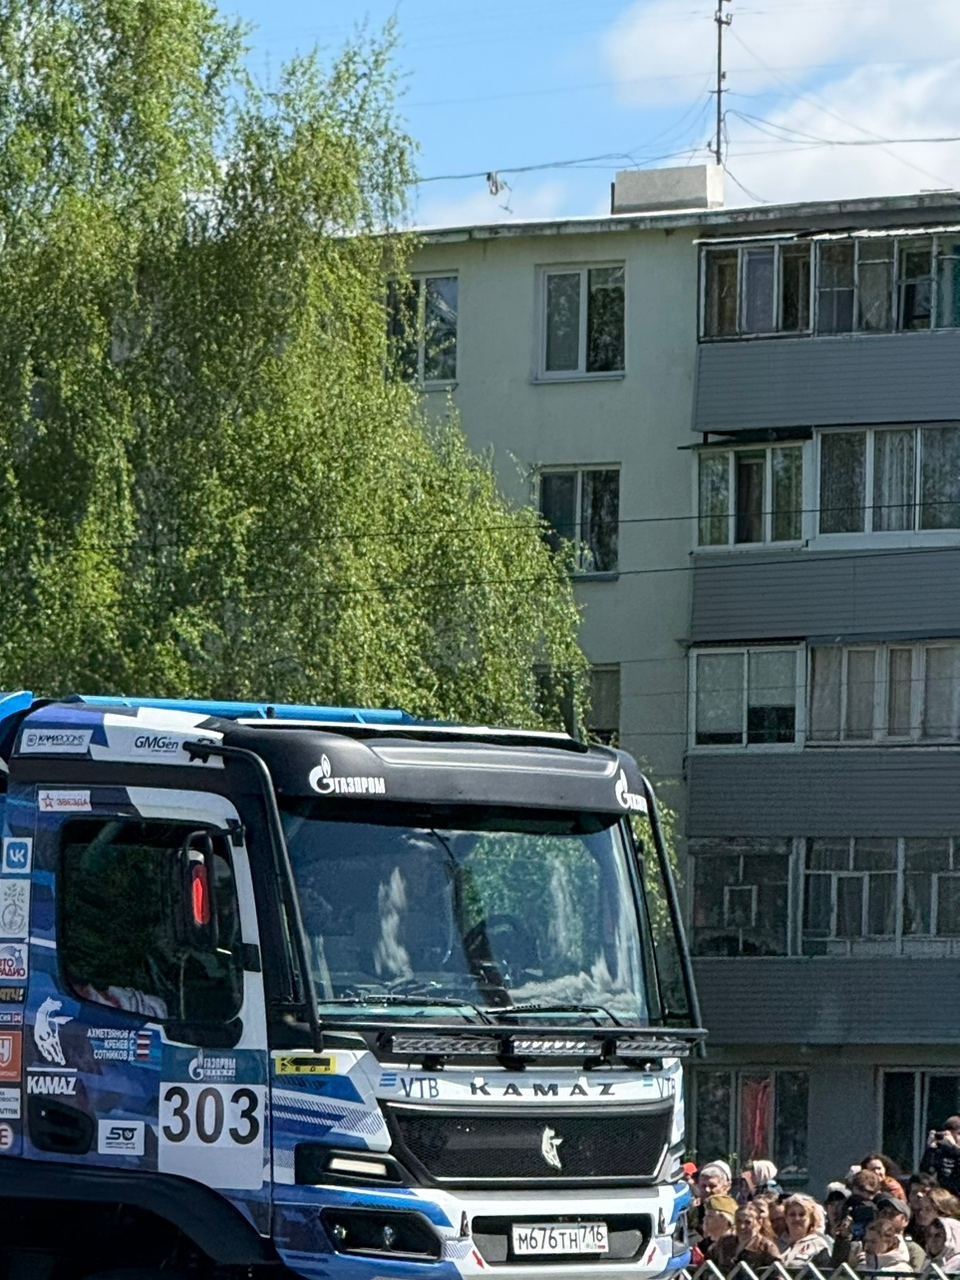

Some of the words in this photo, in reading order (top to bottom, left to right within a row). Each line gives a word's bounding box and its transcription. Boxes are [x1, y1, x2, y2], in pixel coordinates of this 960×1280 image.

[334, 777, 386, 794] ГАЗПРОМ
[26, 1076, 76, 1095] KAMAZ
[401, 1077, 440, 1099] VTB
[470, 1082, 616, 1096] KAMAZ
[162, 1086, 260, 1145] 303
[580, 1225, 604, 1242] 716
